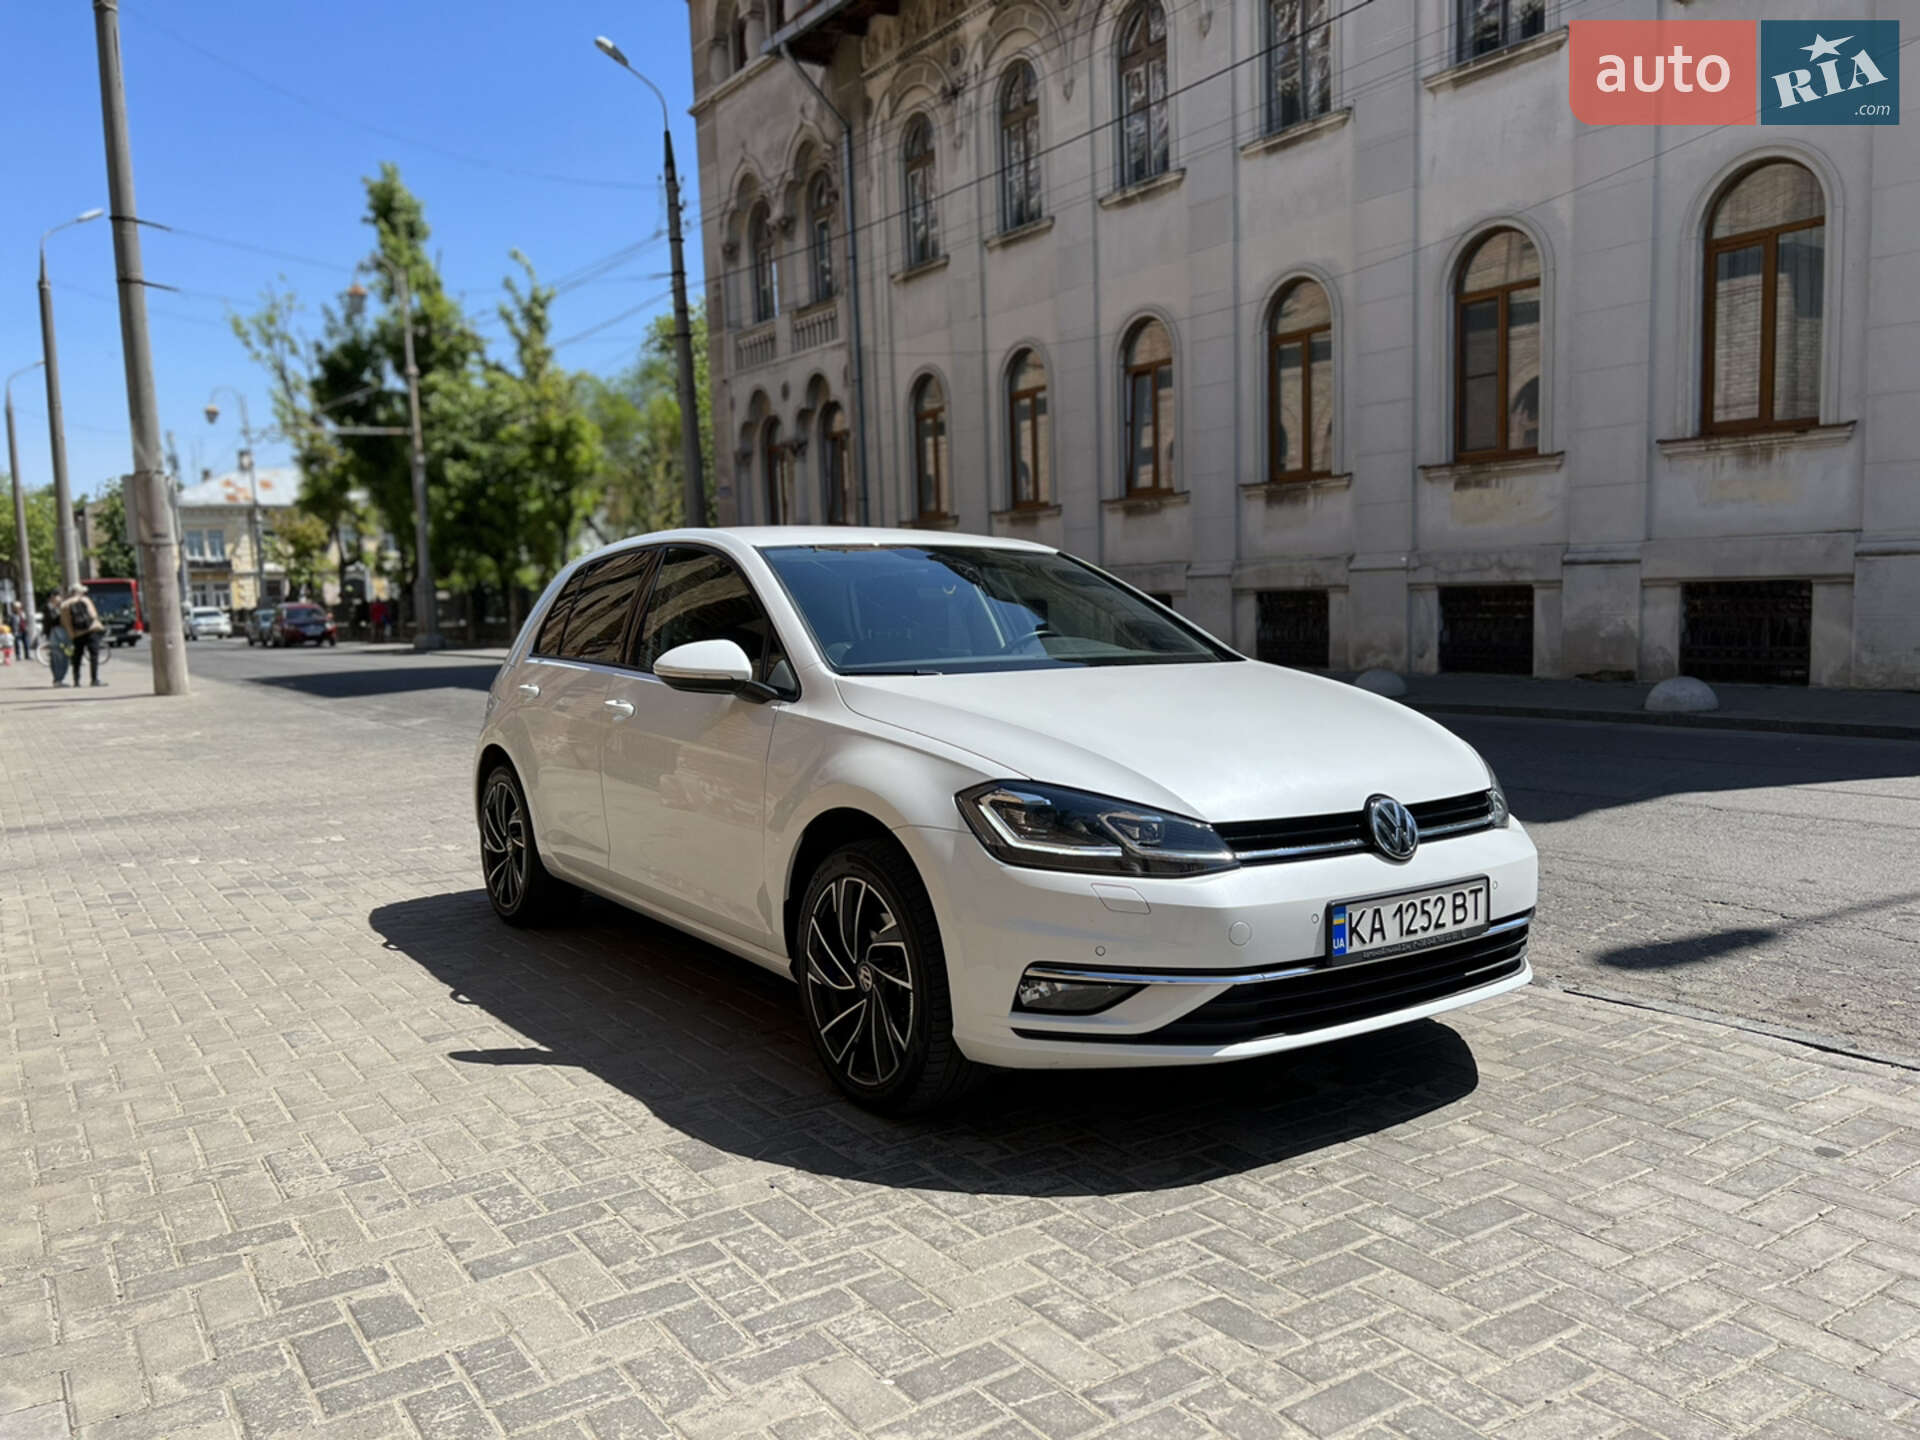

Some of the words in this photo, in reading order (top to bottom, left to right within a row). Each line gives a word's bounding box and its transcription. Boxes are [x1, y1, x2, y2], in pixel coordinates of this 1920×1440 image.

[1348, 908, 1386, 947] KA
[1393, 895, 1446, 937] 1252
[1453, 887, 1483, 925] BT
[1333, 938, 1345, 949] UA
